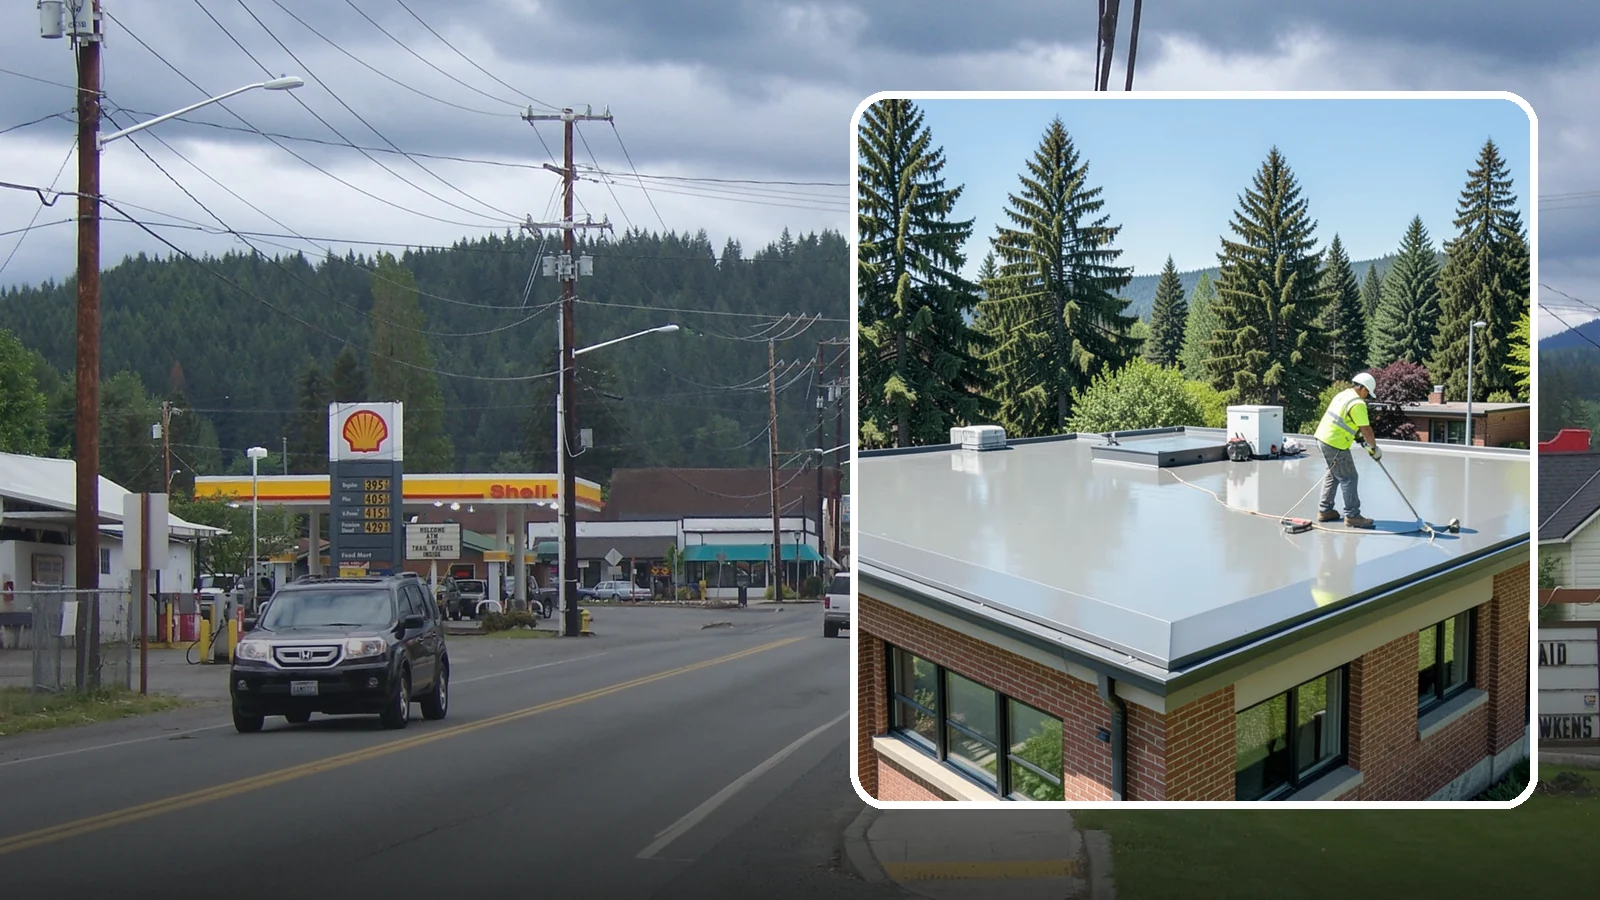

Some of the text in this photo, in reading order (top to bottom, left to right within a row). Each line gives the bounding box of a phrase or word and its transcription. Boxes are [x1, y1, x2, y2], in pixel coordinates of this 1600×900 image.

[366, 480, 384, 490] 395
[490, 484, 547, 499] Shell
[366, 494, 384, 504] 405
[366, 508, 384, 518] 415
[366, 522, 384, 532] 429
[1539, 643, 1566, 665] AID
